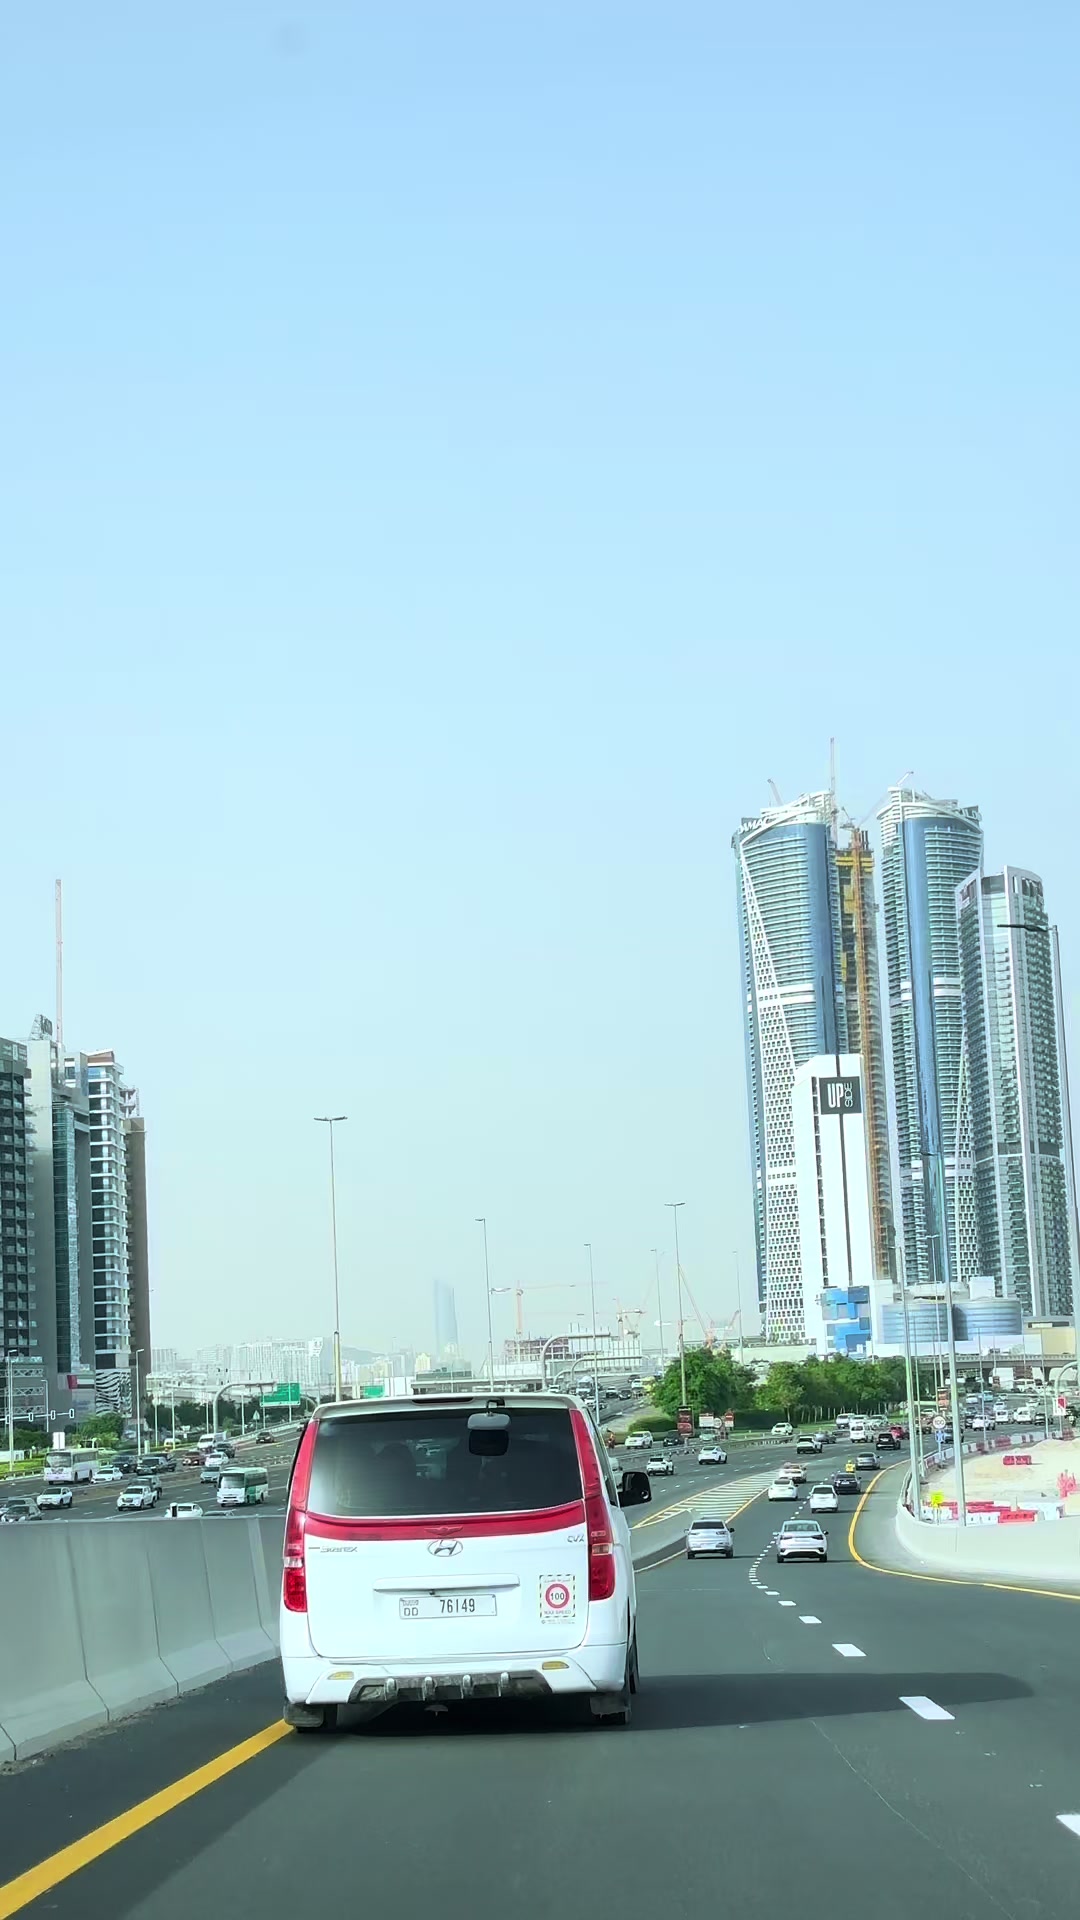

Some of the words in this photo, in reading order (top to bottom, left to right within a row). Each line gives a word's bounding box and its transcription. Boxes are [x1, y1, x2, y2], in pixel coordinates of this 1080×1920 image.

[827, 1082, 844, 1108] UP
[844, 1081, 853, 1108] SIDE
[550, 1592, 565, 1600] 100
[403, 1607, 419, 1616] DD
[439, 1598, 475, 1613] 76149
